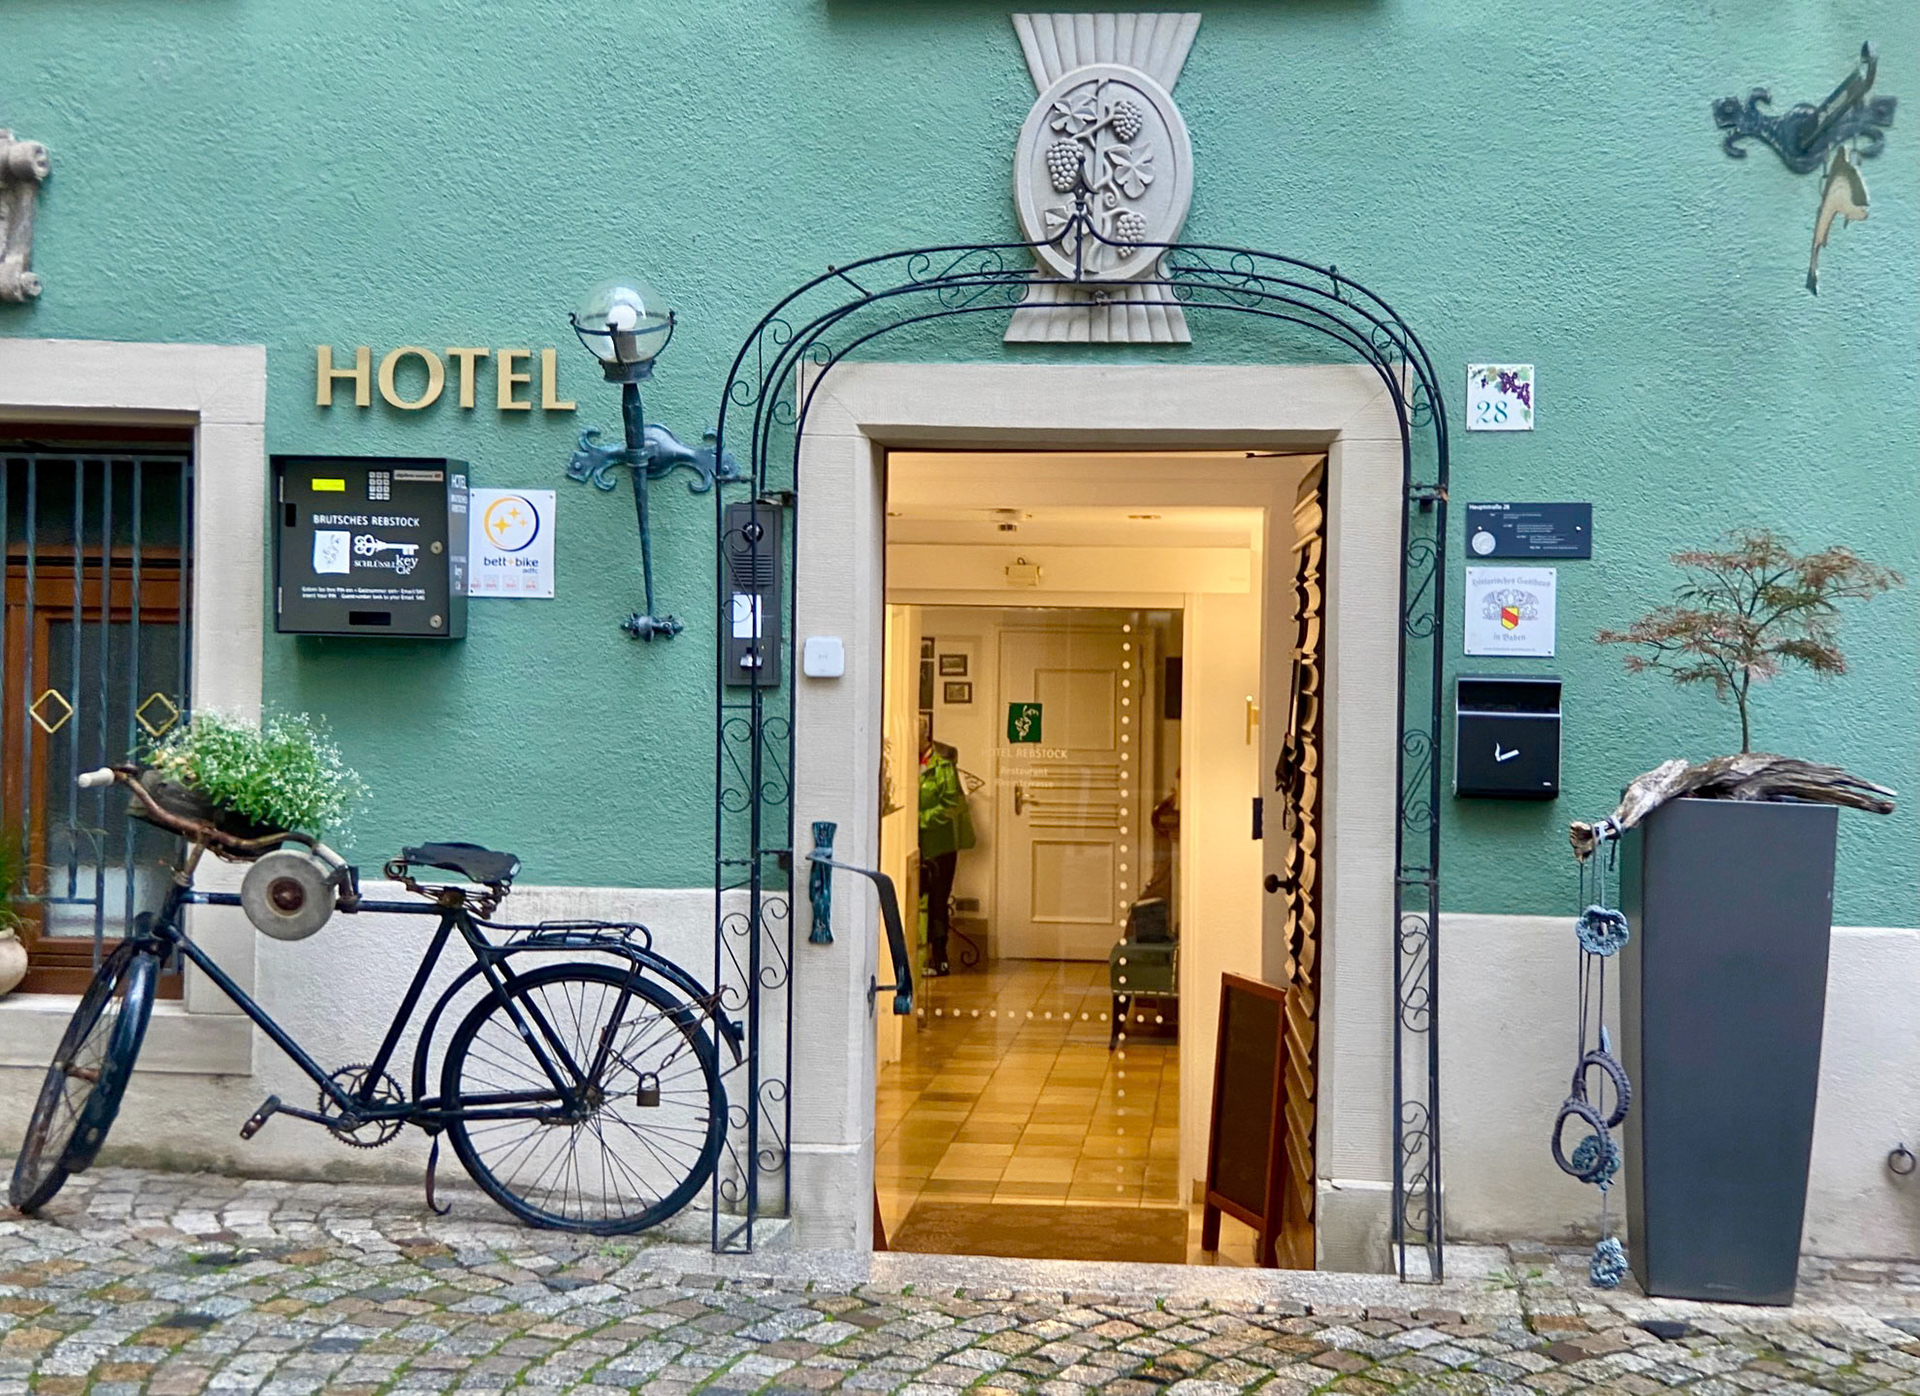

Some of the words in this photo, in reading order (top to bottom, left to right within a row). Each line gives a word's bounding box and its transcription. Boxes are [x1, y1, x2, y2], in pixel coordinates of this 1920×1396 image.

[316, 344, 577, 410] HOTEL
[1476, 400, 1508, 424] 28
[313, 514, 369, 526] BRUTSCHES
[371, 516, 420, 527] REBSTOCK
[396, 554, 419, 570] key
[1472, 576, 1516, 588] Historisches
[1517, 576, 1551, 587] Gasthaus
[1502, 633, 1527, 641] Baden
[1015, 749, 1068, 759] REBSTOCK
